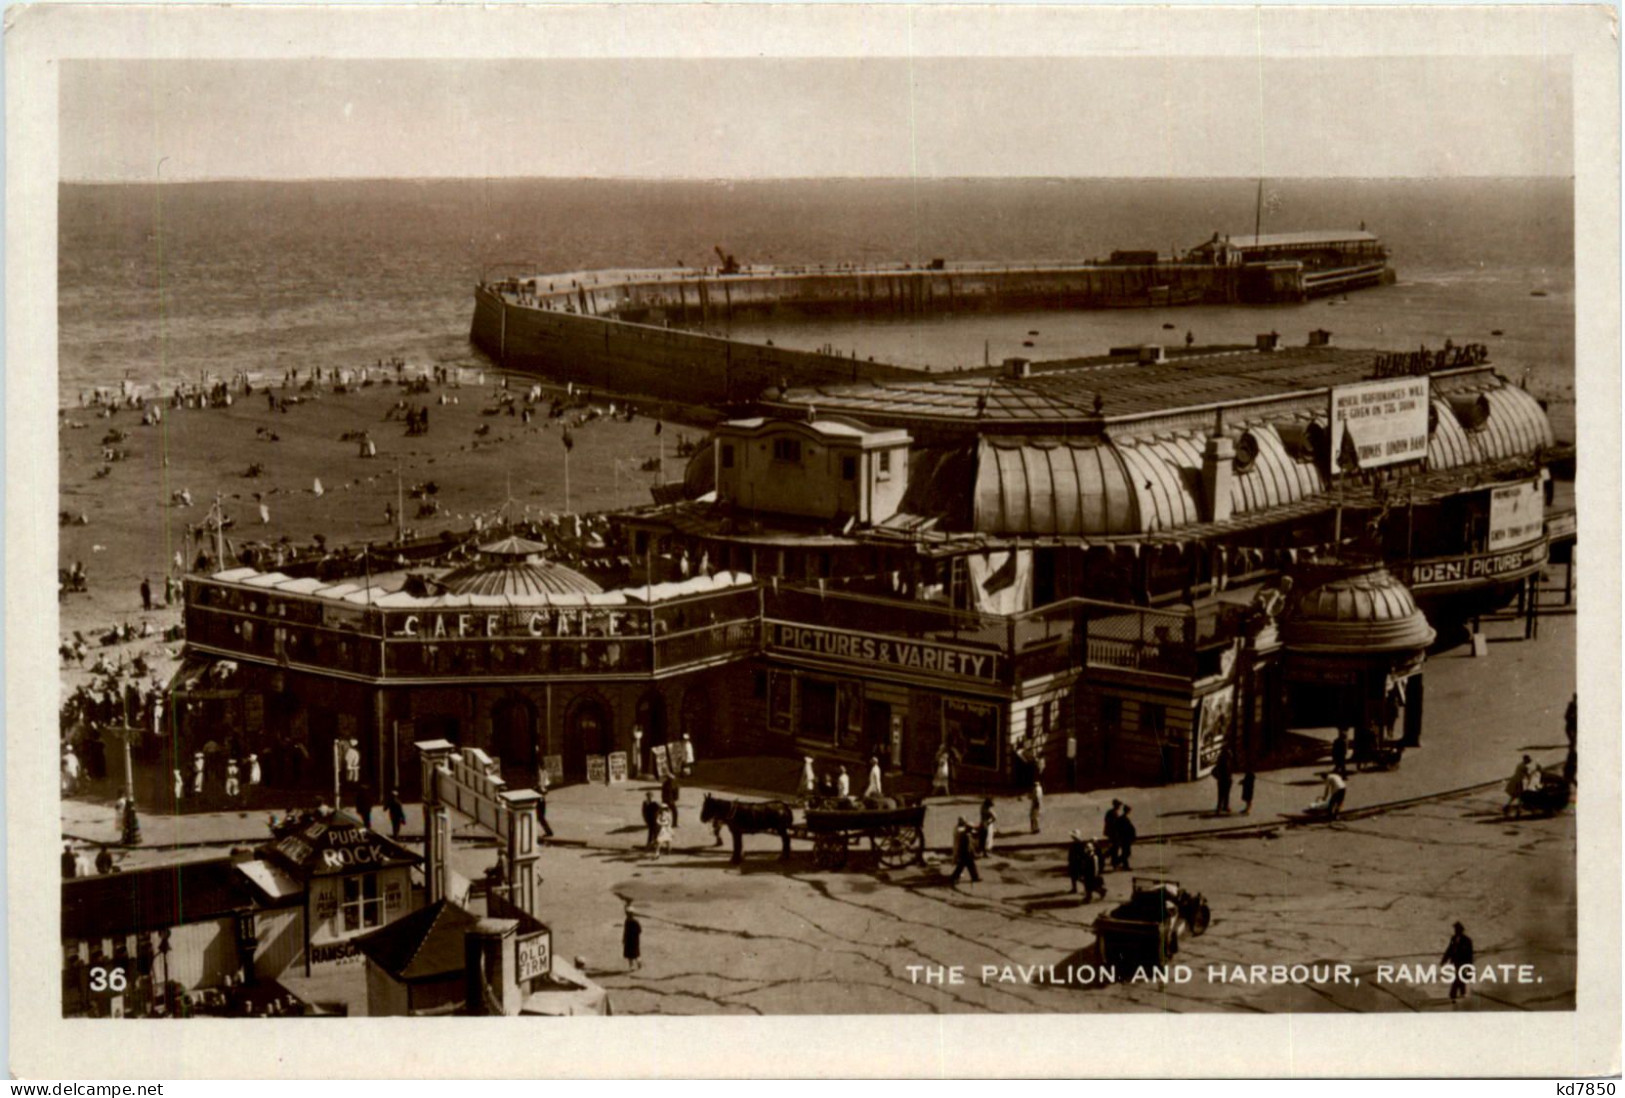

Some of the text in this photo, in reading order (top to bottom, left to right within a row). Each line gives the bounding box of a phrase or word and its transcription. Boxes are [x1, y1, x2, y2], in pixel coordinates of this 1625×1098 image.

[1409, 384, 1425, 397] WILL
[1349, 405, 1370, 419] GIVEN
[1473, 552, 1522, 575] PICTURES
[781, 626, 985, 678] PICTURES & VARIETY
[328, 827, 369, 845] PURE
[322, 844, 387, 867] ROCK
[520, 944, 546, 963] OLD
[519, 955, 548, 977] FIRM
